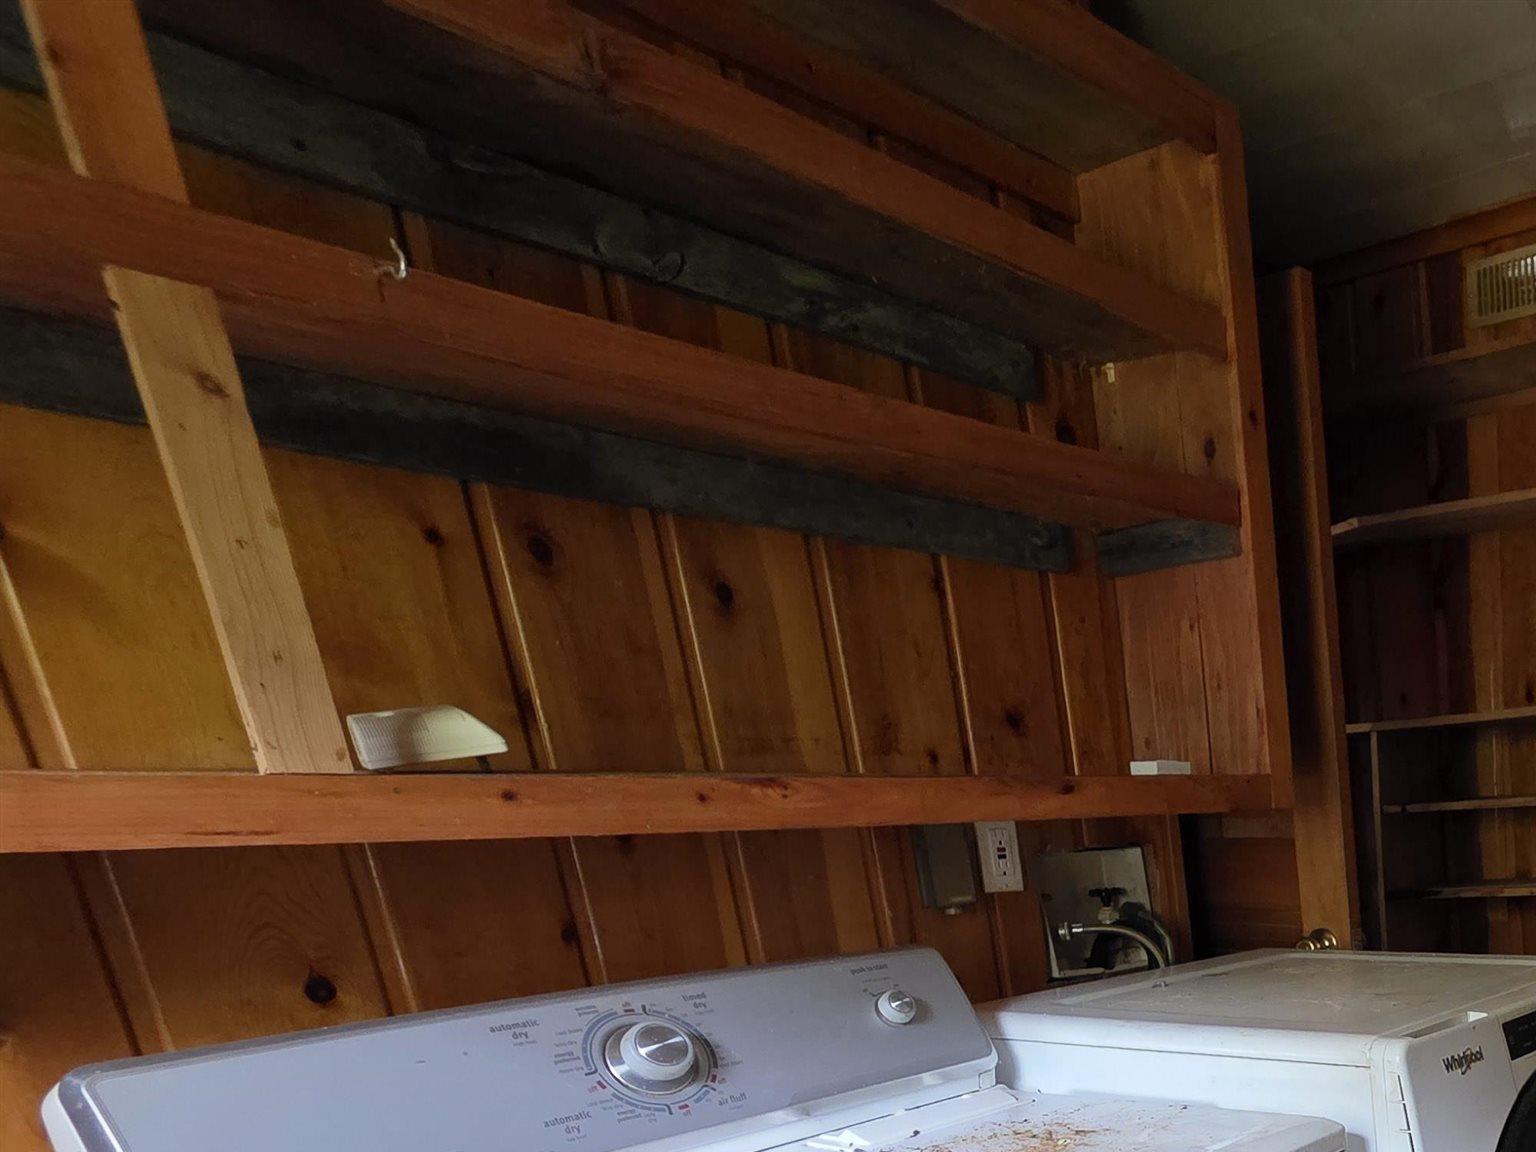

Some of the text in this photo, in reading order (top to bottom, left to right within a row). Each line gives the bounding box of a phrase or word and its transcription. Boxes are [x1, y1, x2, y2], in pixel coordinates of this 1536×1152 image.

[680, 991, 707, 1002] timed
[693, 1001, 707, 1010] dry
[489, 1018, 540, 1033] automatic
[512, 1030, 529, 1040] dry
[1442, 1045, 1485, 1076] Whirlpool
[543, 1110, 592, 1128] automatic
[564, 1124, 581, 1135] dry
